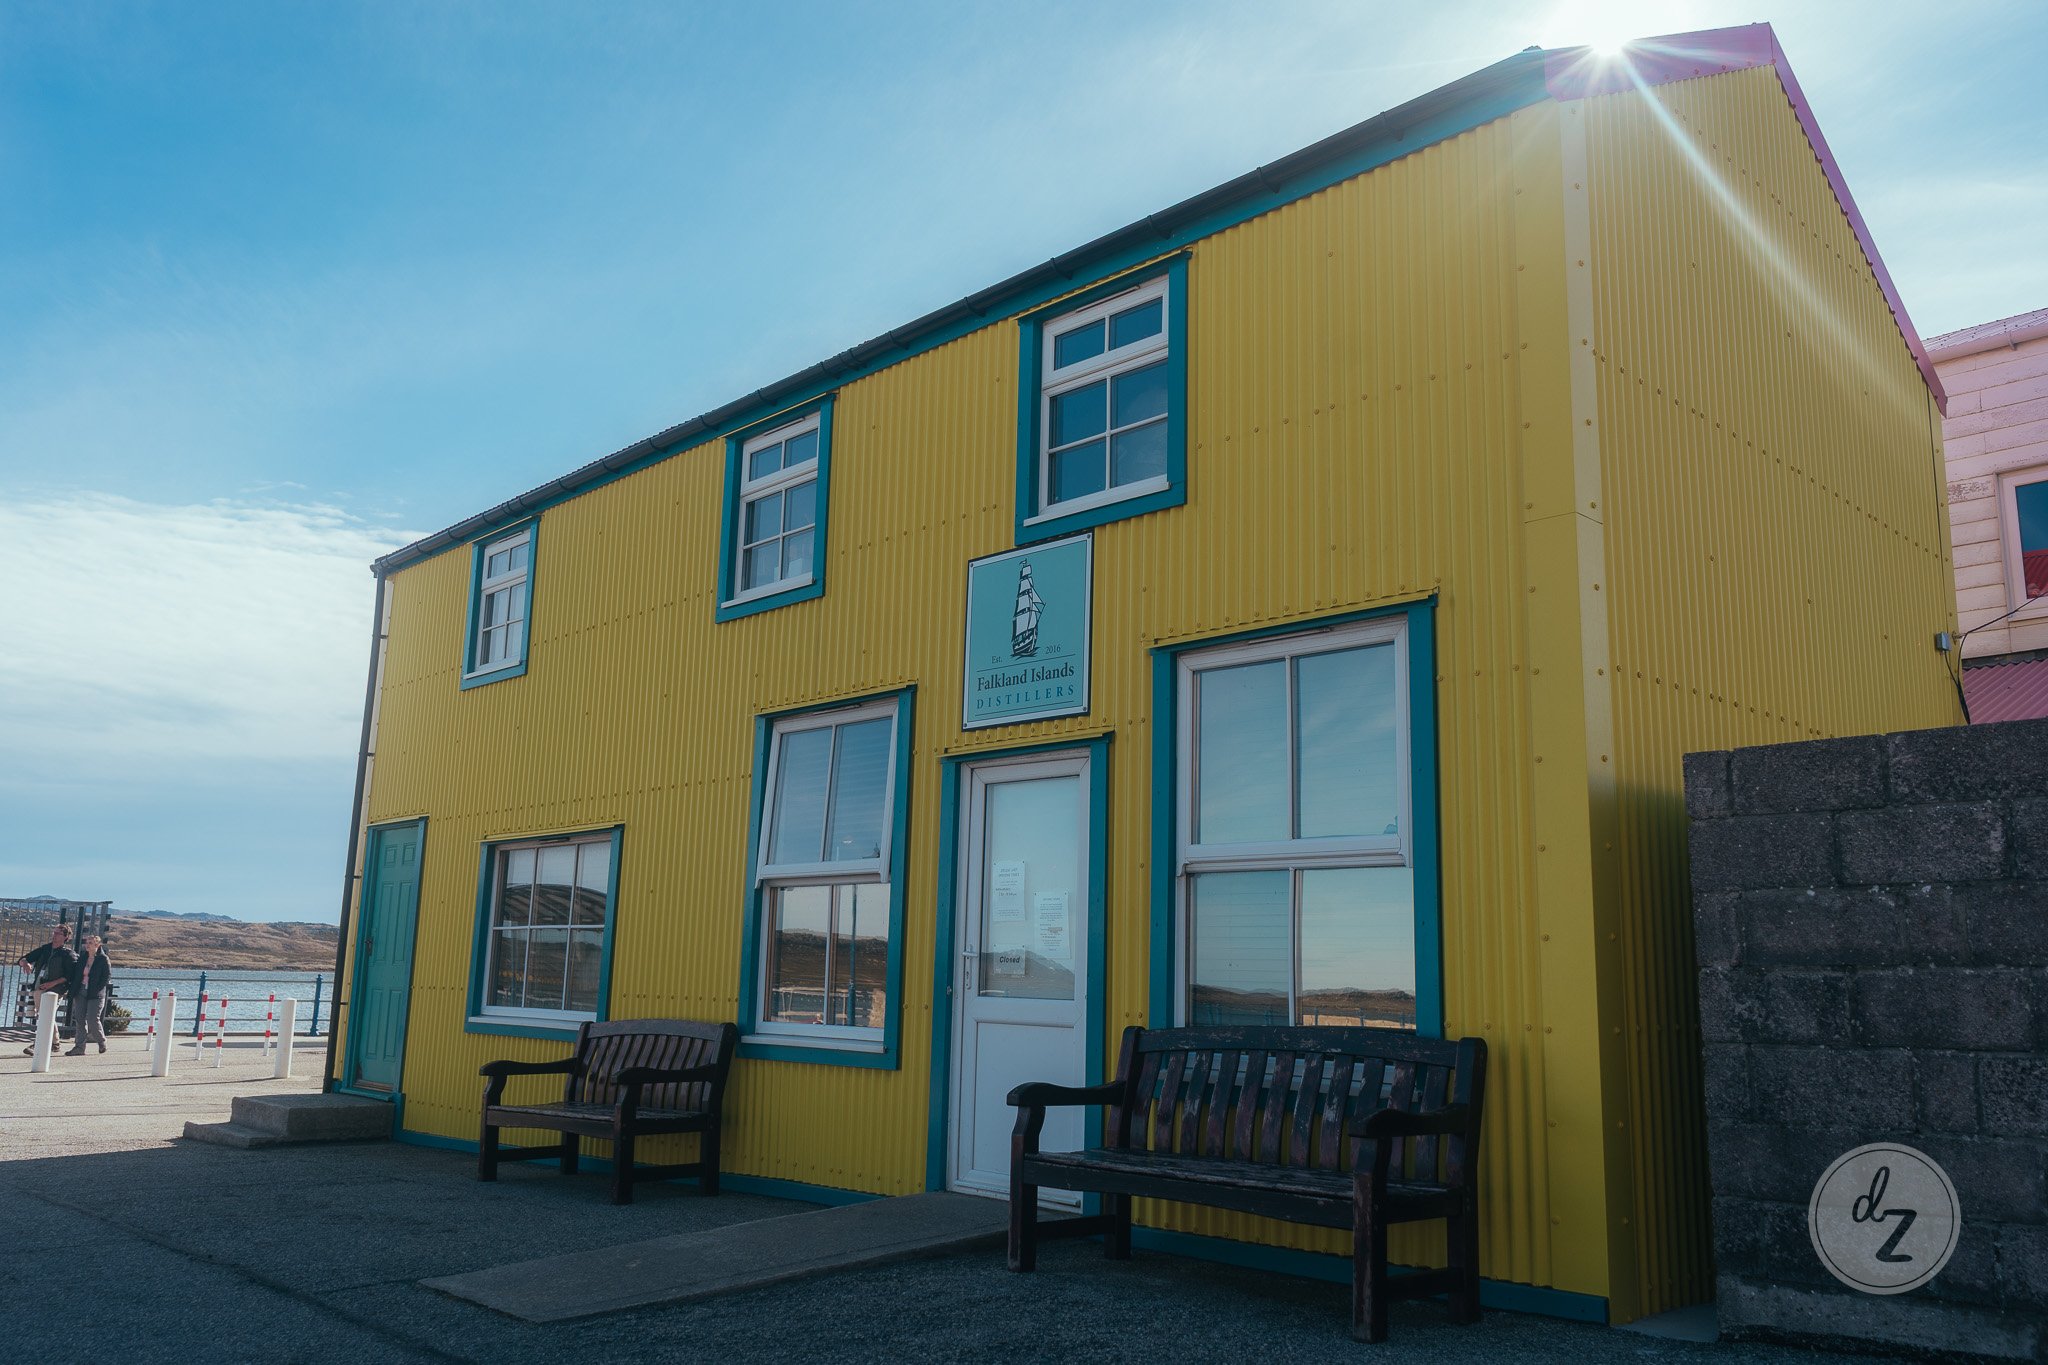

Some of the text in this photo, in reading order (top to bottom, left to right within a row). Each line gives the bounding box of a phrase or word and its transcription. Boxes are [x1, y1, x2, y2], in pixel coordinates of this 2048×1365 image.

[991, 645, 1061, 664] Est. 2016
[977, 662, 1075, 692] Falkland Islands
[976, 684, 1075, 709] DISTILLERS
[999, 956, 1021, 964] Closed
